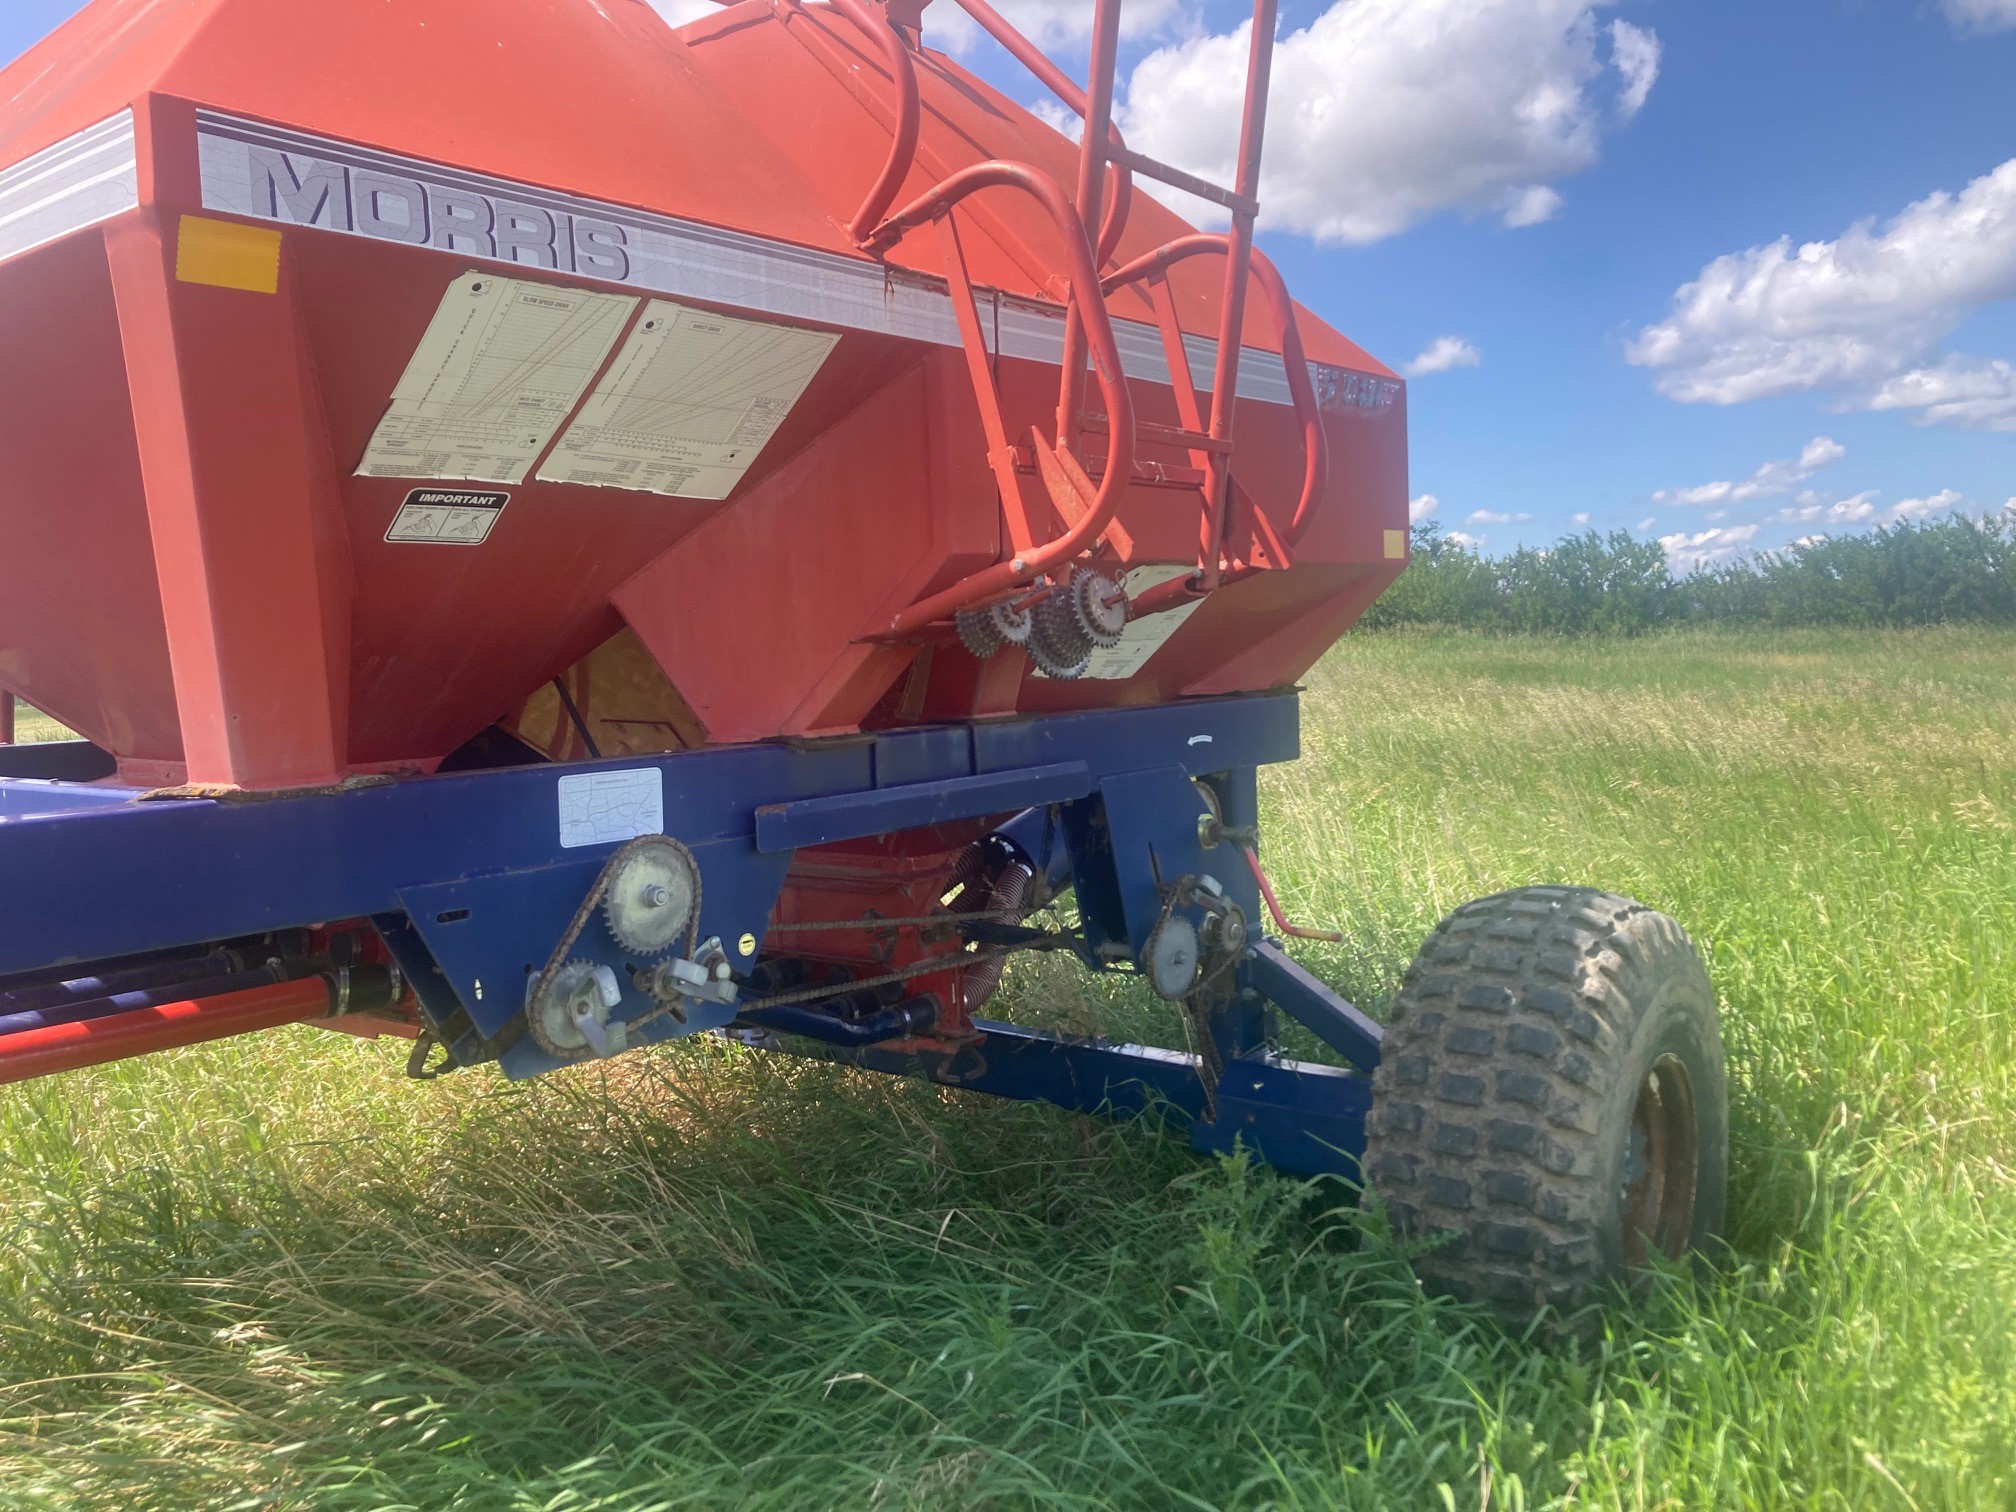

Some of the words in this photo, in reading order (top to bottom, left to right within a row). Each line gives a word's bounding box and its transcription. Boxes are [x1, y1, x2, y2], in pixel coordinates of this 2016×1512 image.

[248, 145, 630, 281] MORRIS
[538, 299, 555, 307] SPEED
[418, 493, 497, 505] IMPORTANT
